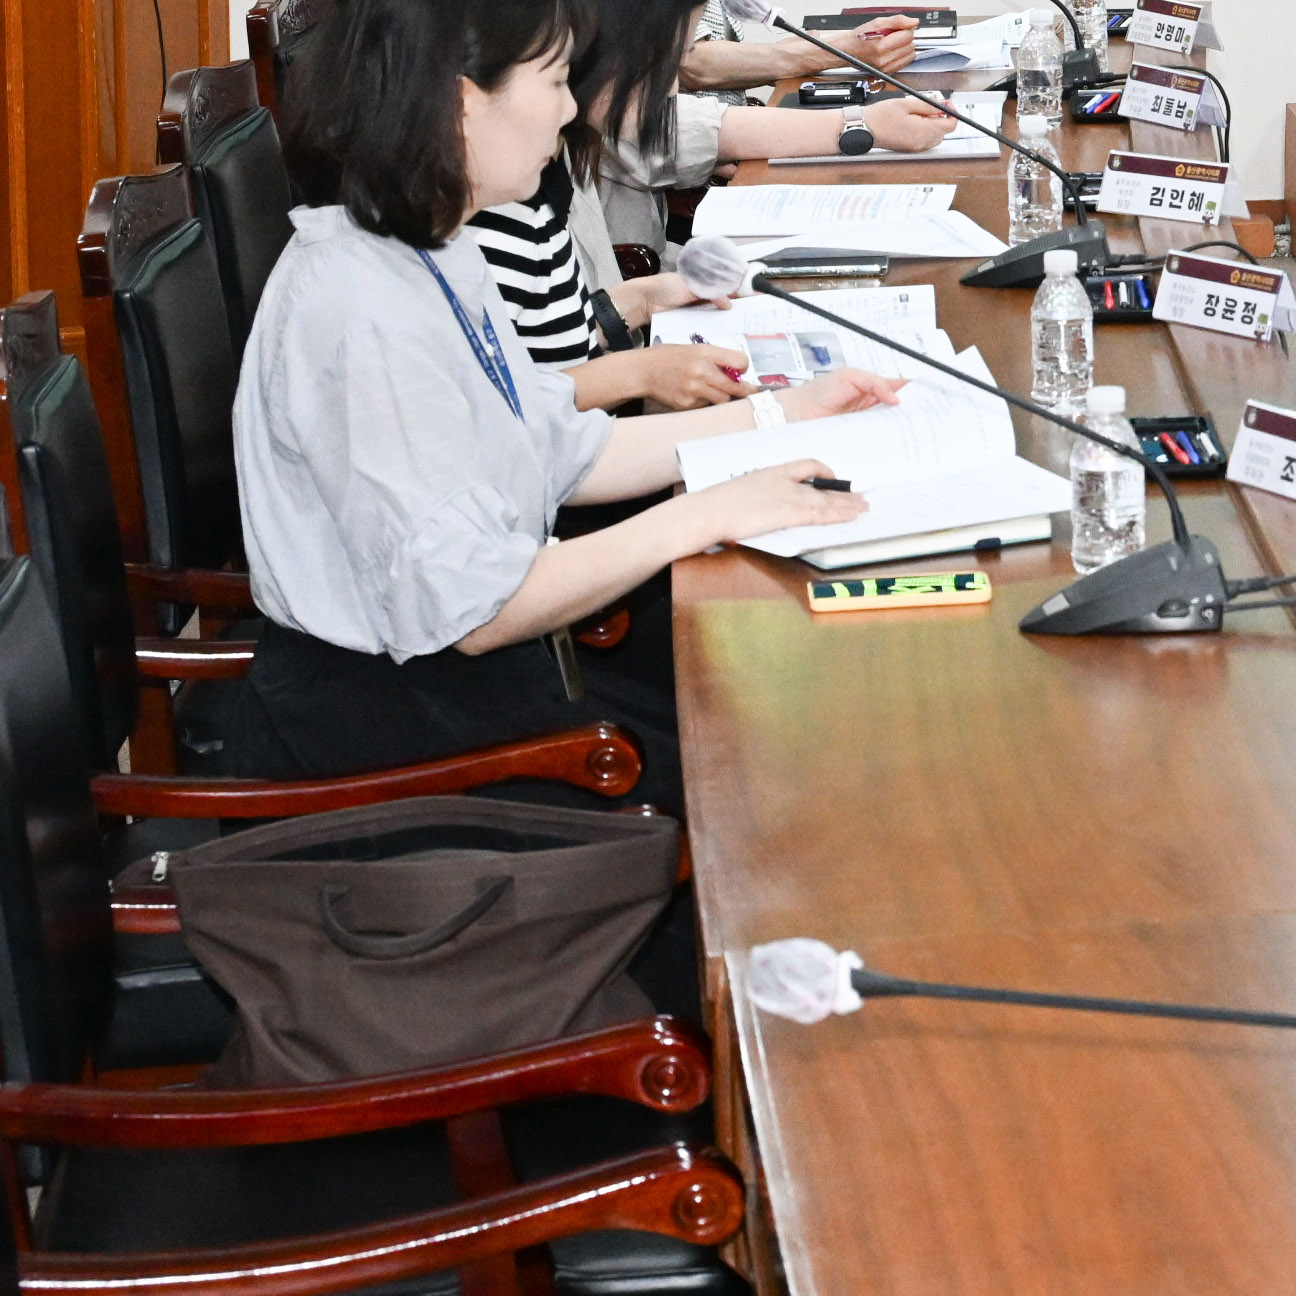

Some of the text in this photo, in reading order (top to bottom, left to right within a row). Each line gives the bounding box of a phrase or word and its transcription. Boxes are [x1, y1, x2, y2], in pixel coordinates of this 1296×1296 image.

[1154, 22, 1186, 44] 안영미
[1149, 186, 1205, 213] 김인혜
[1203, 293, 1258, 326] 장윤정
